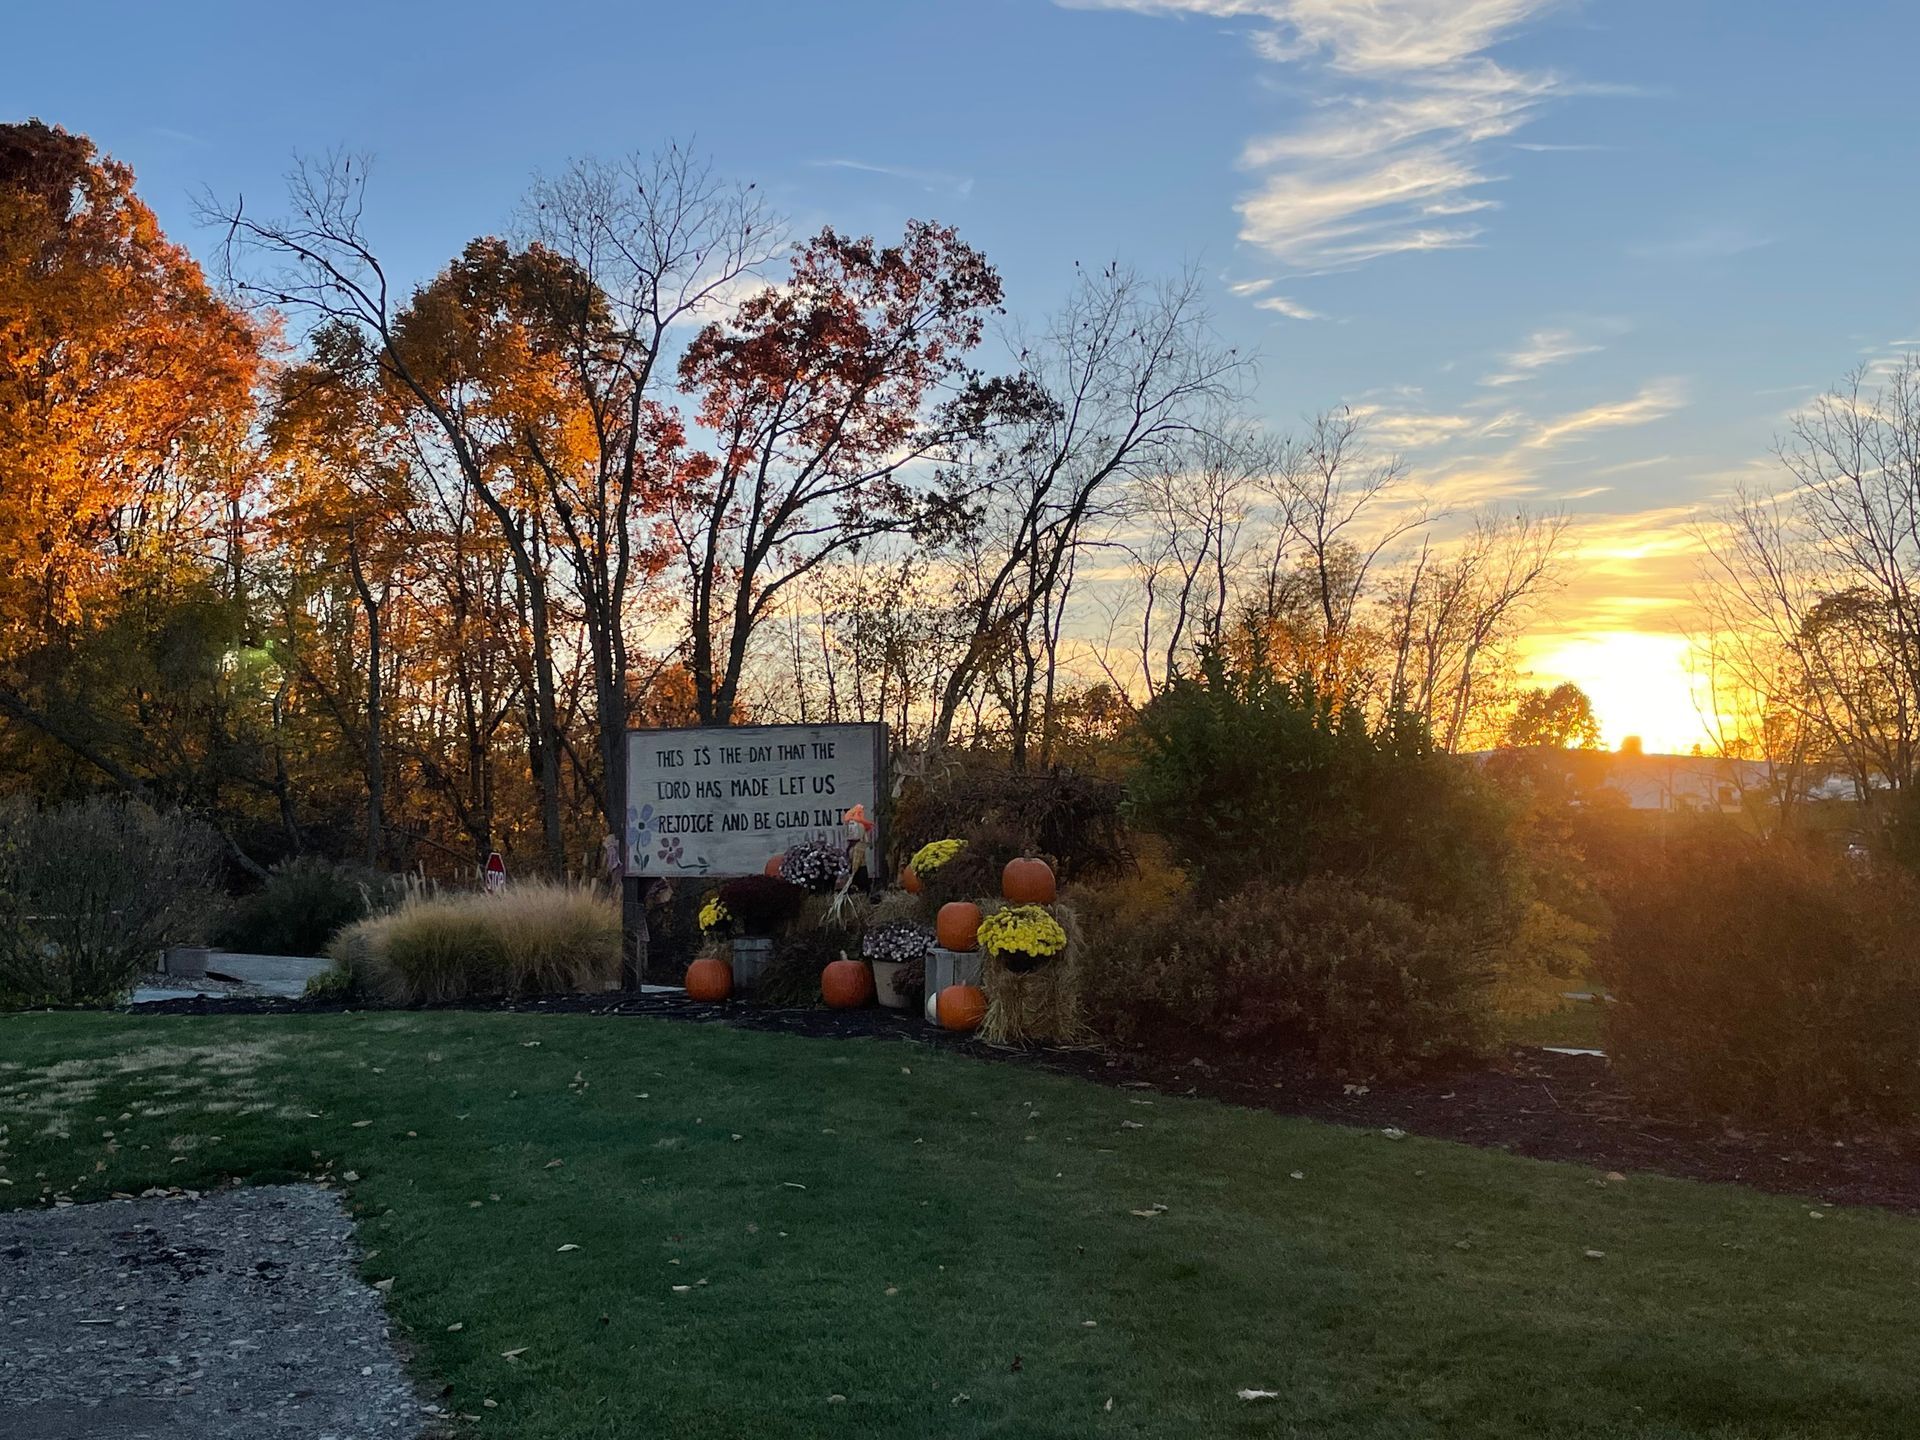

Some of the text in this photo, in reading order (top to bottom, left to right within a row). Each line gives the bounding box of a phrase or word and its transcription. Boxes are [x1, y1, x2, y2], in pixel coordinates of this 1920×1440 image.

[656, 743, 835, 767] THIS IS THE DAY THAT THE
[657, 774, 835, 800] LORD HAS MADE LET US
[658, 814, 714, 834] REJOICE
[722, 813, 749, 832] AND
[754, 812, 772, 830] BE
[776, 811, 809, 829] GLAD
[814, 810, 832, 827] IN
[487, 870, 504, 890] STOP
